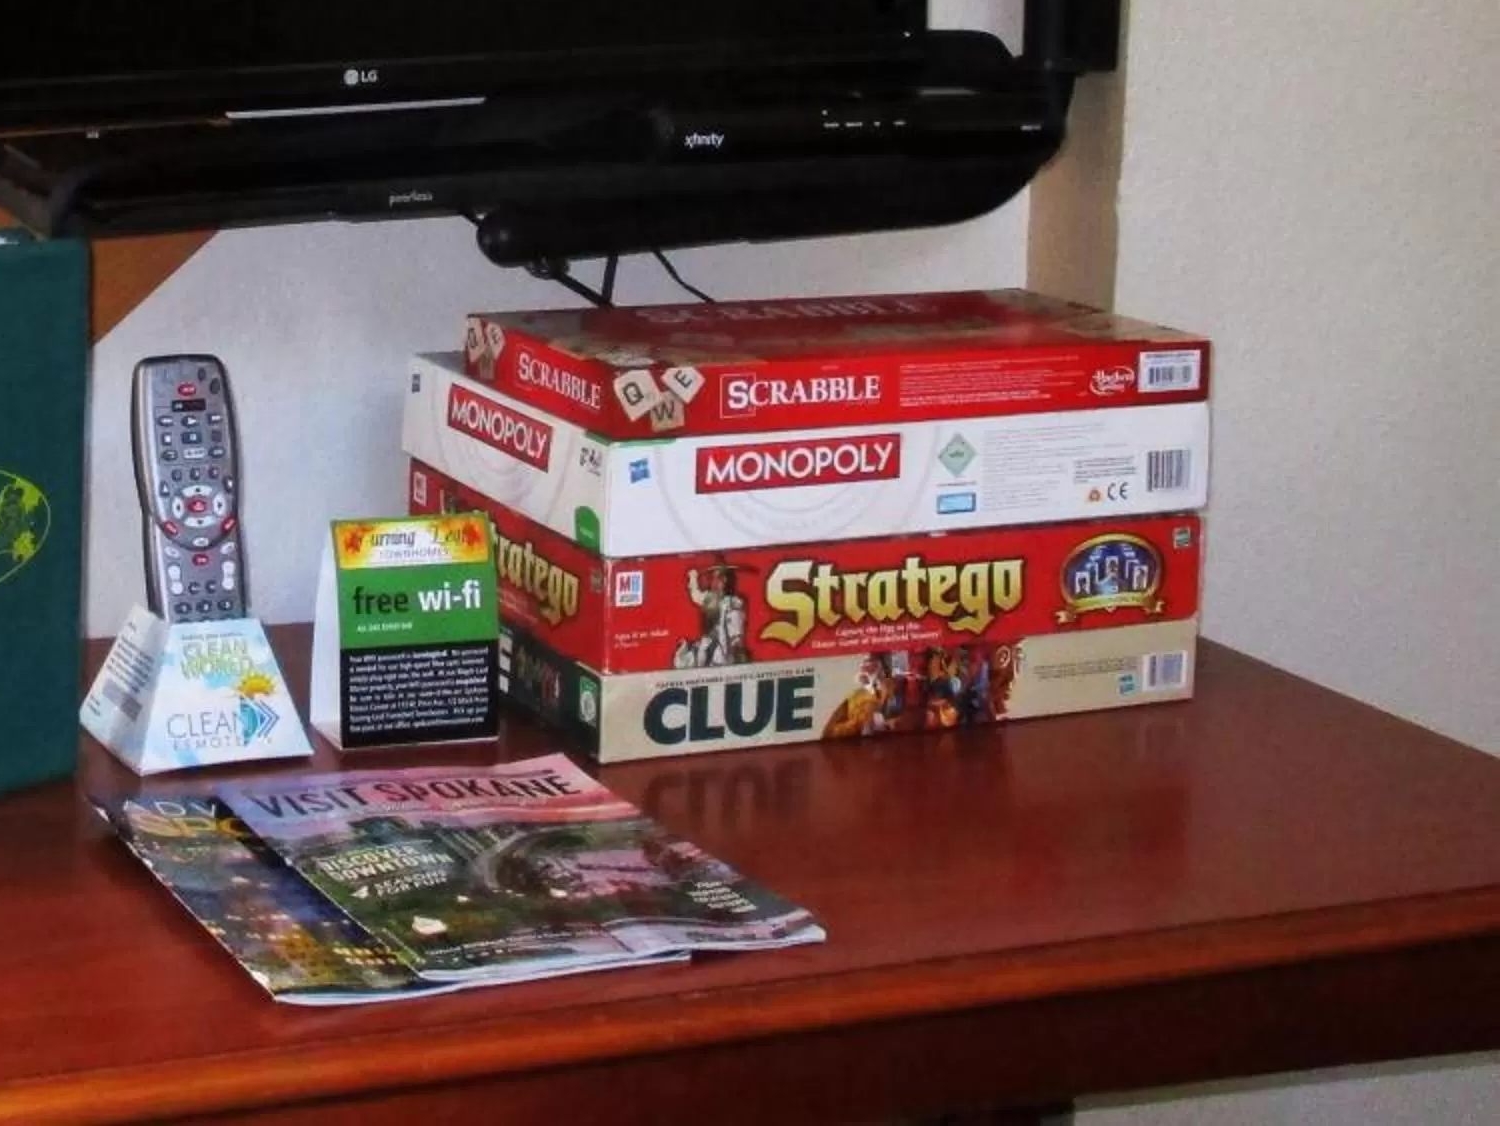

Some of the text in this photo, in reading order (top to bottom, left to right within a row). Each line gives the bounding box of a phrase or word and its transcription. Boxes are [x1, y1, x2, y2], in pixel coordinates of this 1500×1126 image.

[517, 351, 600, 409] SCRABBLE
[622, 381, 645, 407] Q
[673, 370, 693, 389] E
[727, 374, 881, 411] SCRABBLE
[451, 394, 548, 459] MONOPOLY
[705, 441, 893, 485] MONOPOLY
[490, 522, 579, 625] ratego
[353, 586, 409, 615] free
[417, 579, 481, 613] wi-fi
[760, 557, 1024, 648] Stratego
[643, 676, 815, 745] CLUE
[252, 774, 582, 819] VISIT SPOKANE
